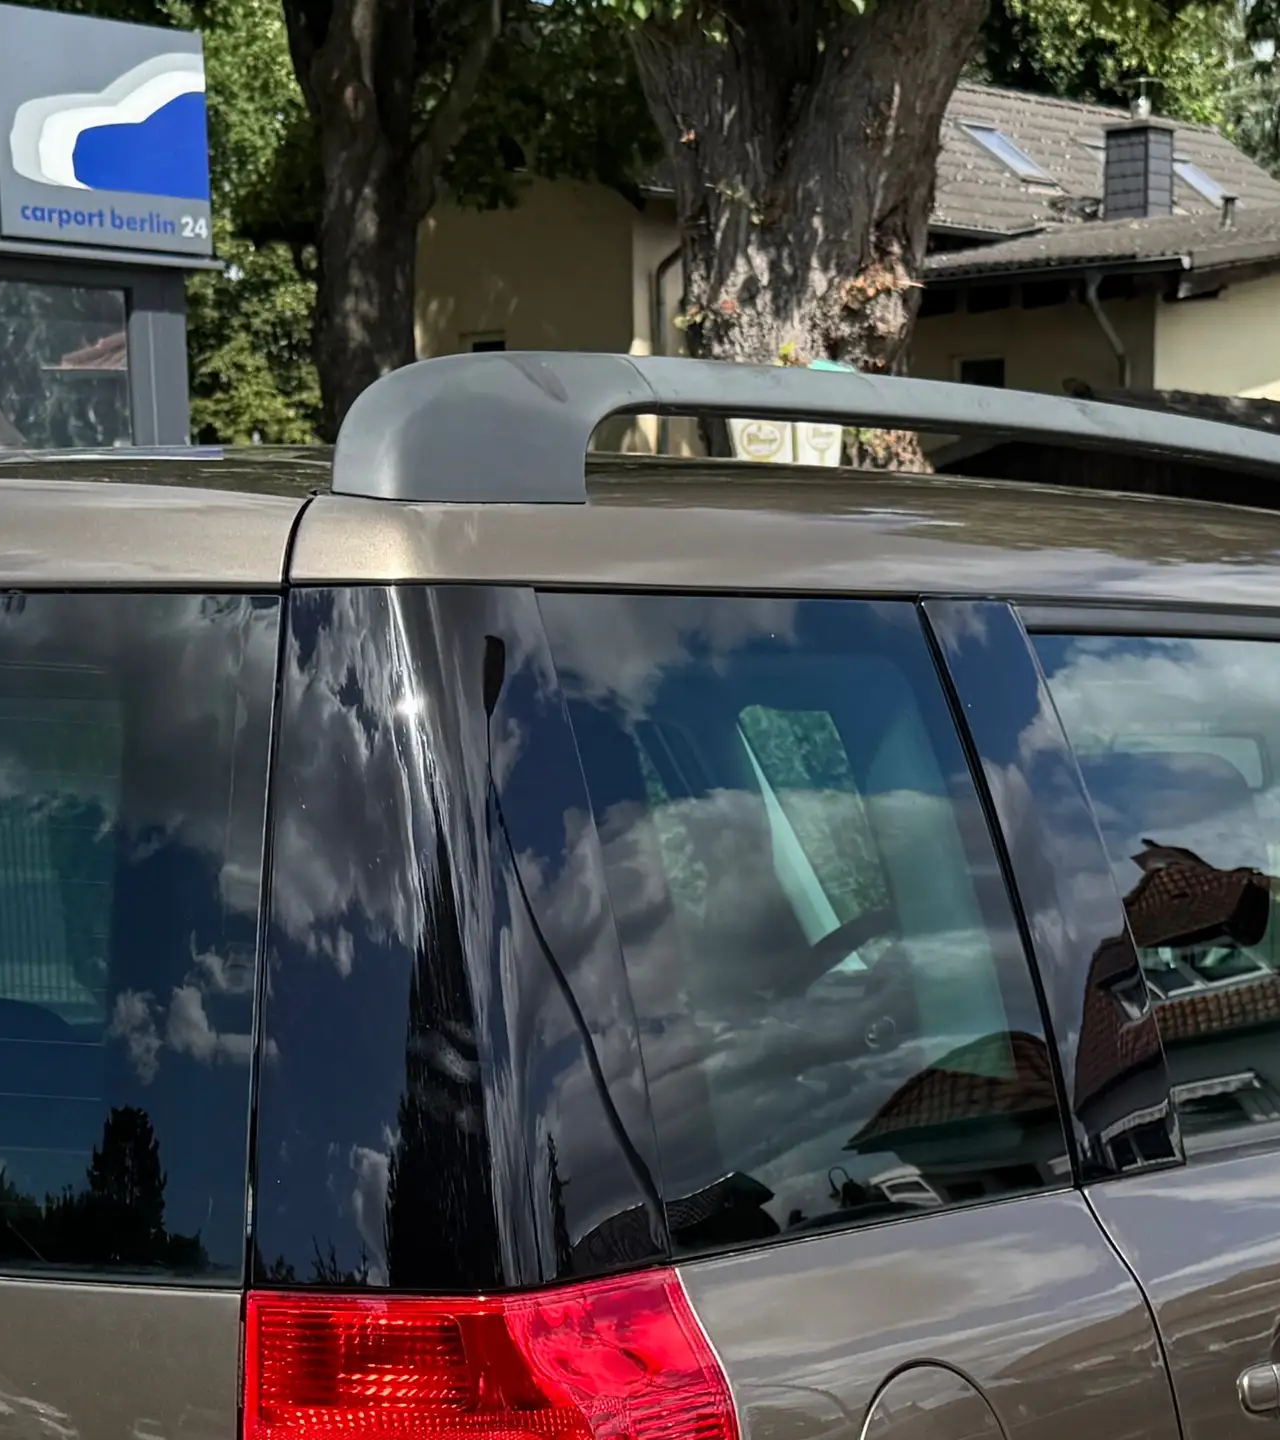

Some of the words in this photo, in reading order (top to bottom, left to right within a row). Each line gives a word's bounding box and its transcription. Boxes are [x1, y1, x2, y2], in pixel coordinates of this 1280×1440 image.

[21, 204, 105, 230] carport
[110, 204, 176, 236] berlin
[180, 215, 208, 240] 24
